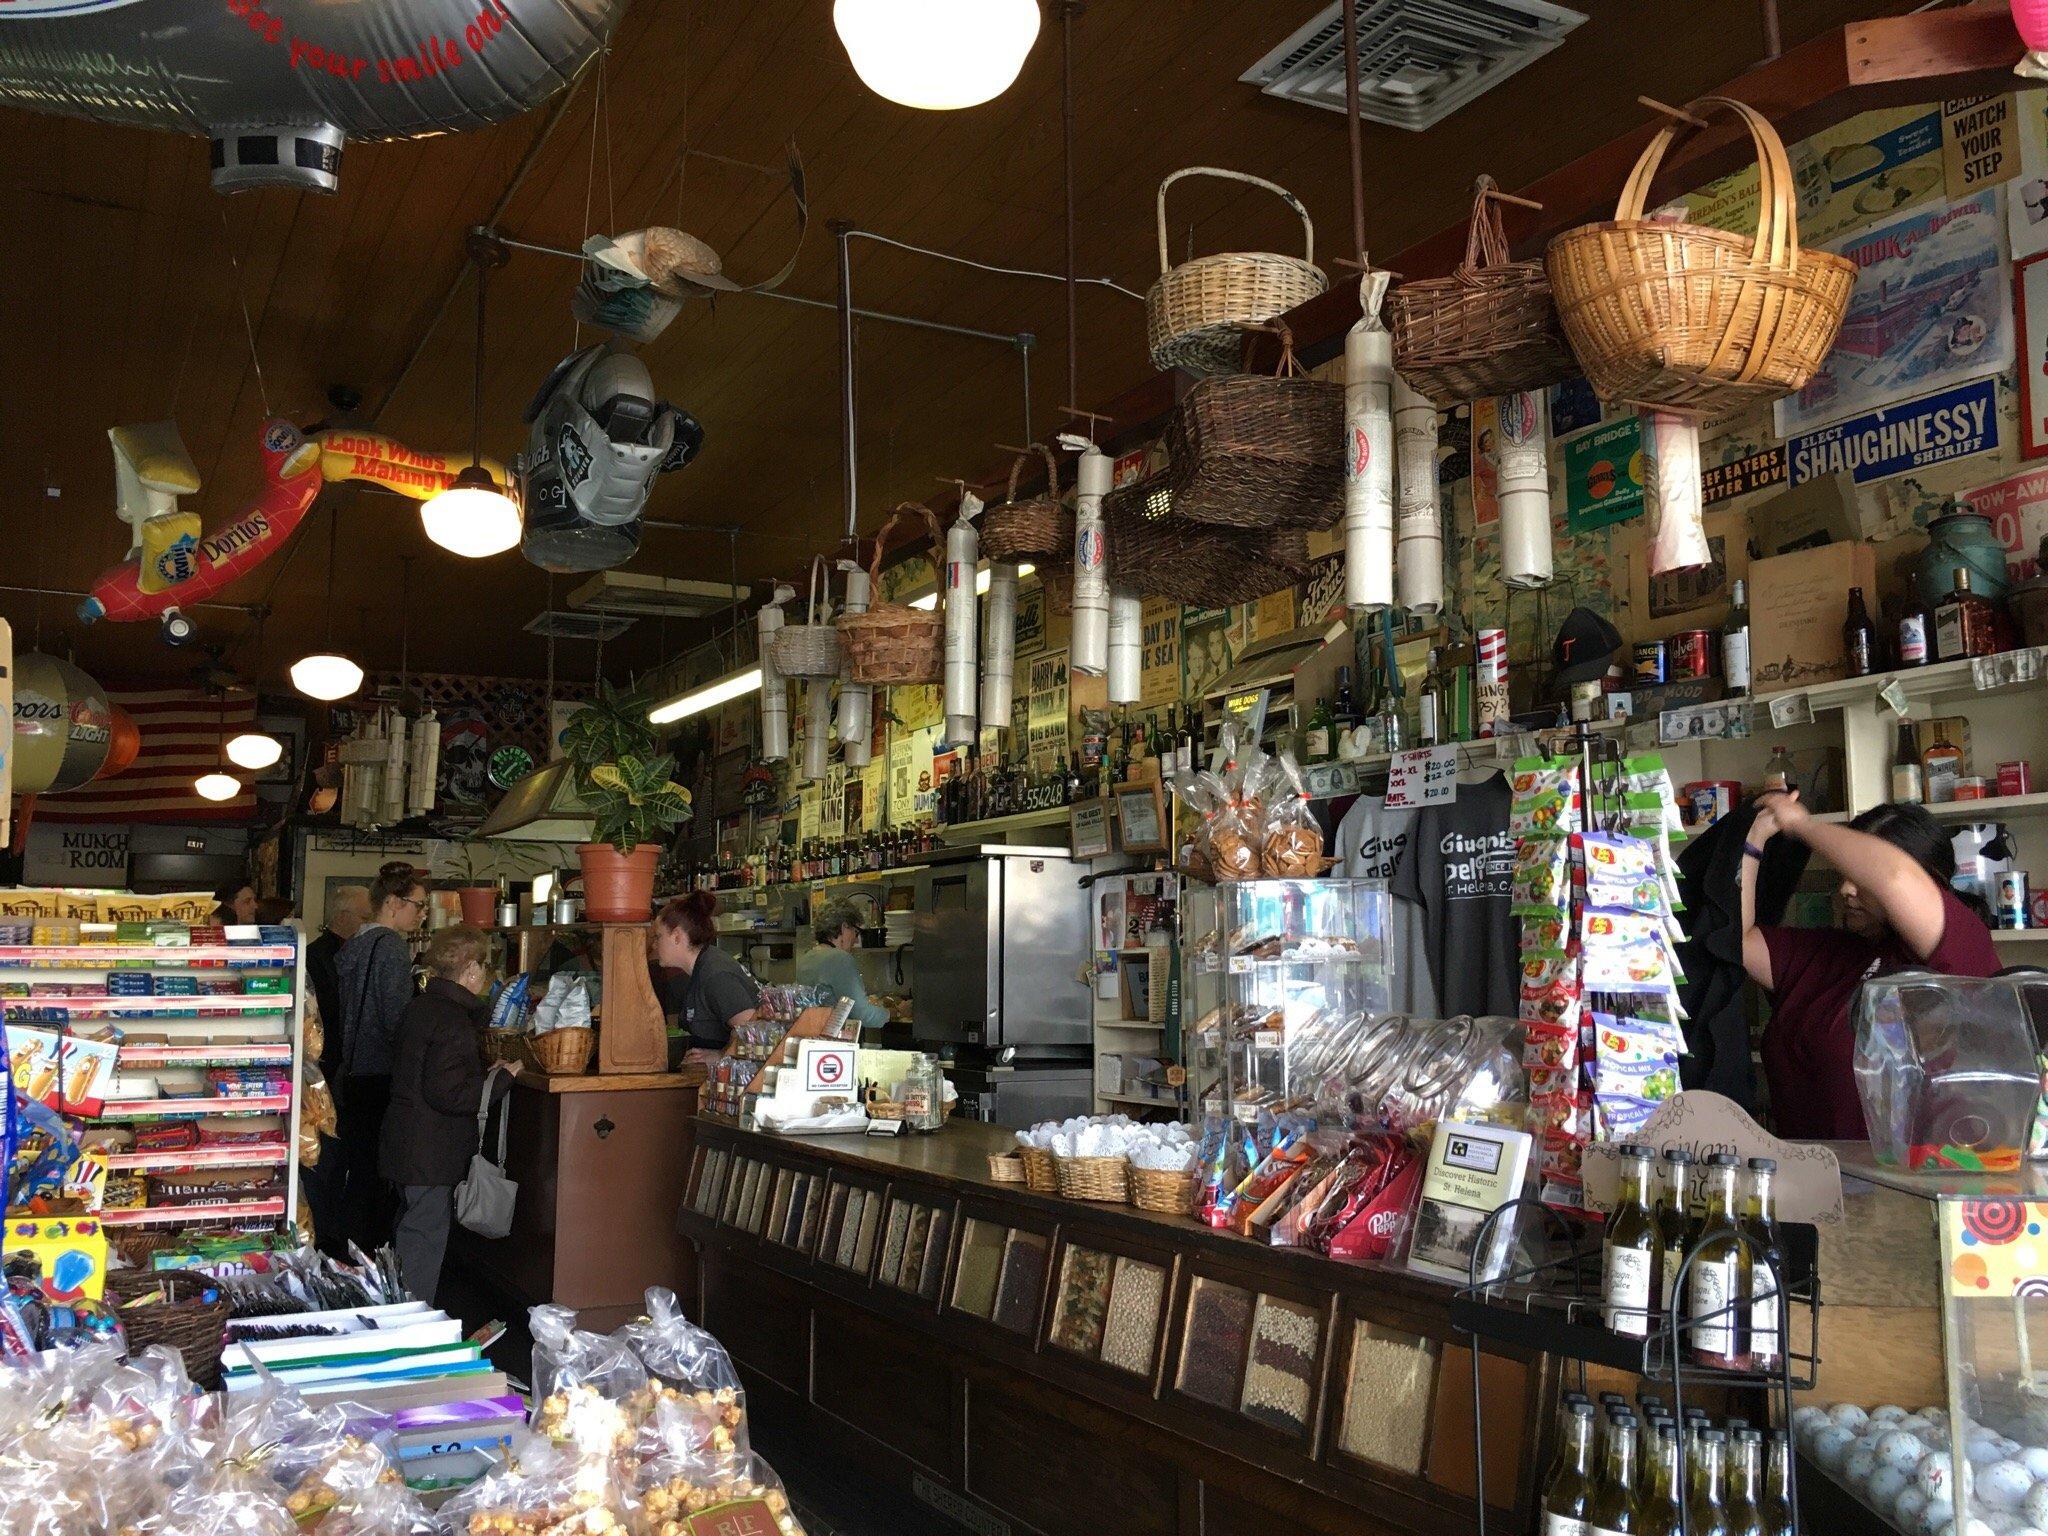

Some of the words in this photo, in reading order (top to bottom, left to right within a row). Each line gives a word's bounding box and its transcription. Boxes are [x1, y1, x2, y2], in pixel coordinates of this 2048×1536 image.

[290, 35, 368, 81] your
[376, 34, 464, 84] smile
[1953, 99, 2007, 139] WATCH
[1960, 126, 2002, 160] YOUR
[1963, 151, 2003, 184] STEP
[325, 432, 383, 458] Look
[1593, 425, 1633, 446] BRIDGE
[1795, 397, 1987, 485] SHAUGHNESSY
[1801, 427, 1844, 450] ELECT
[1913, 437, 1983, 466] SHERIFF
[350, 454, 436, 493] Making
[1701, 470, 1721, 487] EEF
[1725, 451, 1778, 480] EATERS
[1701, 478, 1743, 504] ETTER
[1971, 477, 2048, 513] TOW-AW
[201, 513, 270, 566] Doritos
[1155, 642, 1174, 667] SEA
[13, 701, 62, 720] oors
[69, 726, 110, 744] LIGHT
[1030, 726, 1044, 743] BIG
[1045, 722, 1065, 739] BAND
[62, 831, 130, 851] MUNCH
[187, 840, 204, 849] EXIT
[70, 850, 126, 869] ROOM
[1457, 879, 1498, 894] Helea,
[1434, 1166, 1467, 1182] Discover
[1467, 1173, 1498, 1188] Historic
[1454, 1184, 1481, 1198] Helena
[1383, 1210, 1398, 1221] Dr
